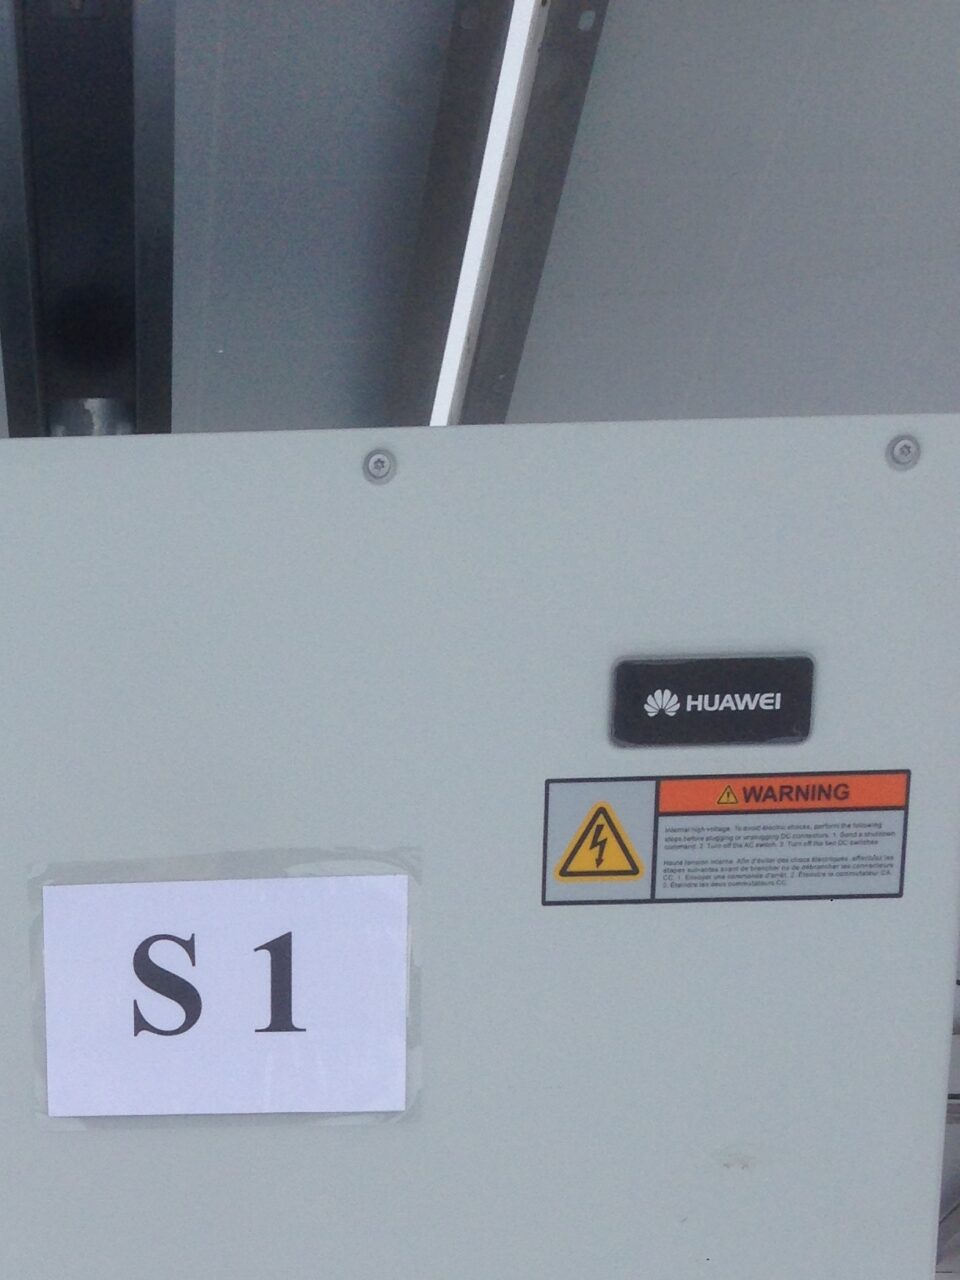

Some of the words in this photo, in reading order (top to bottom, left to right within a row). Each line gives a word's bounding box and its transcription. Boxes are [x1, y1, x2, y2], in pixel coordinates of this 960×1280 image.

[686, 692, 782, 712] HUAWEI
[742, 783, 850, 803] WARNING
[132, 932, 203, 1038] S
[253, 930, 307, 1033] 1
